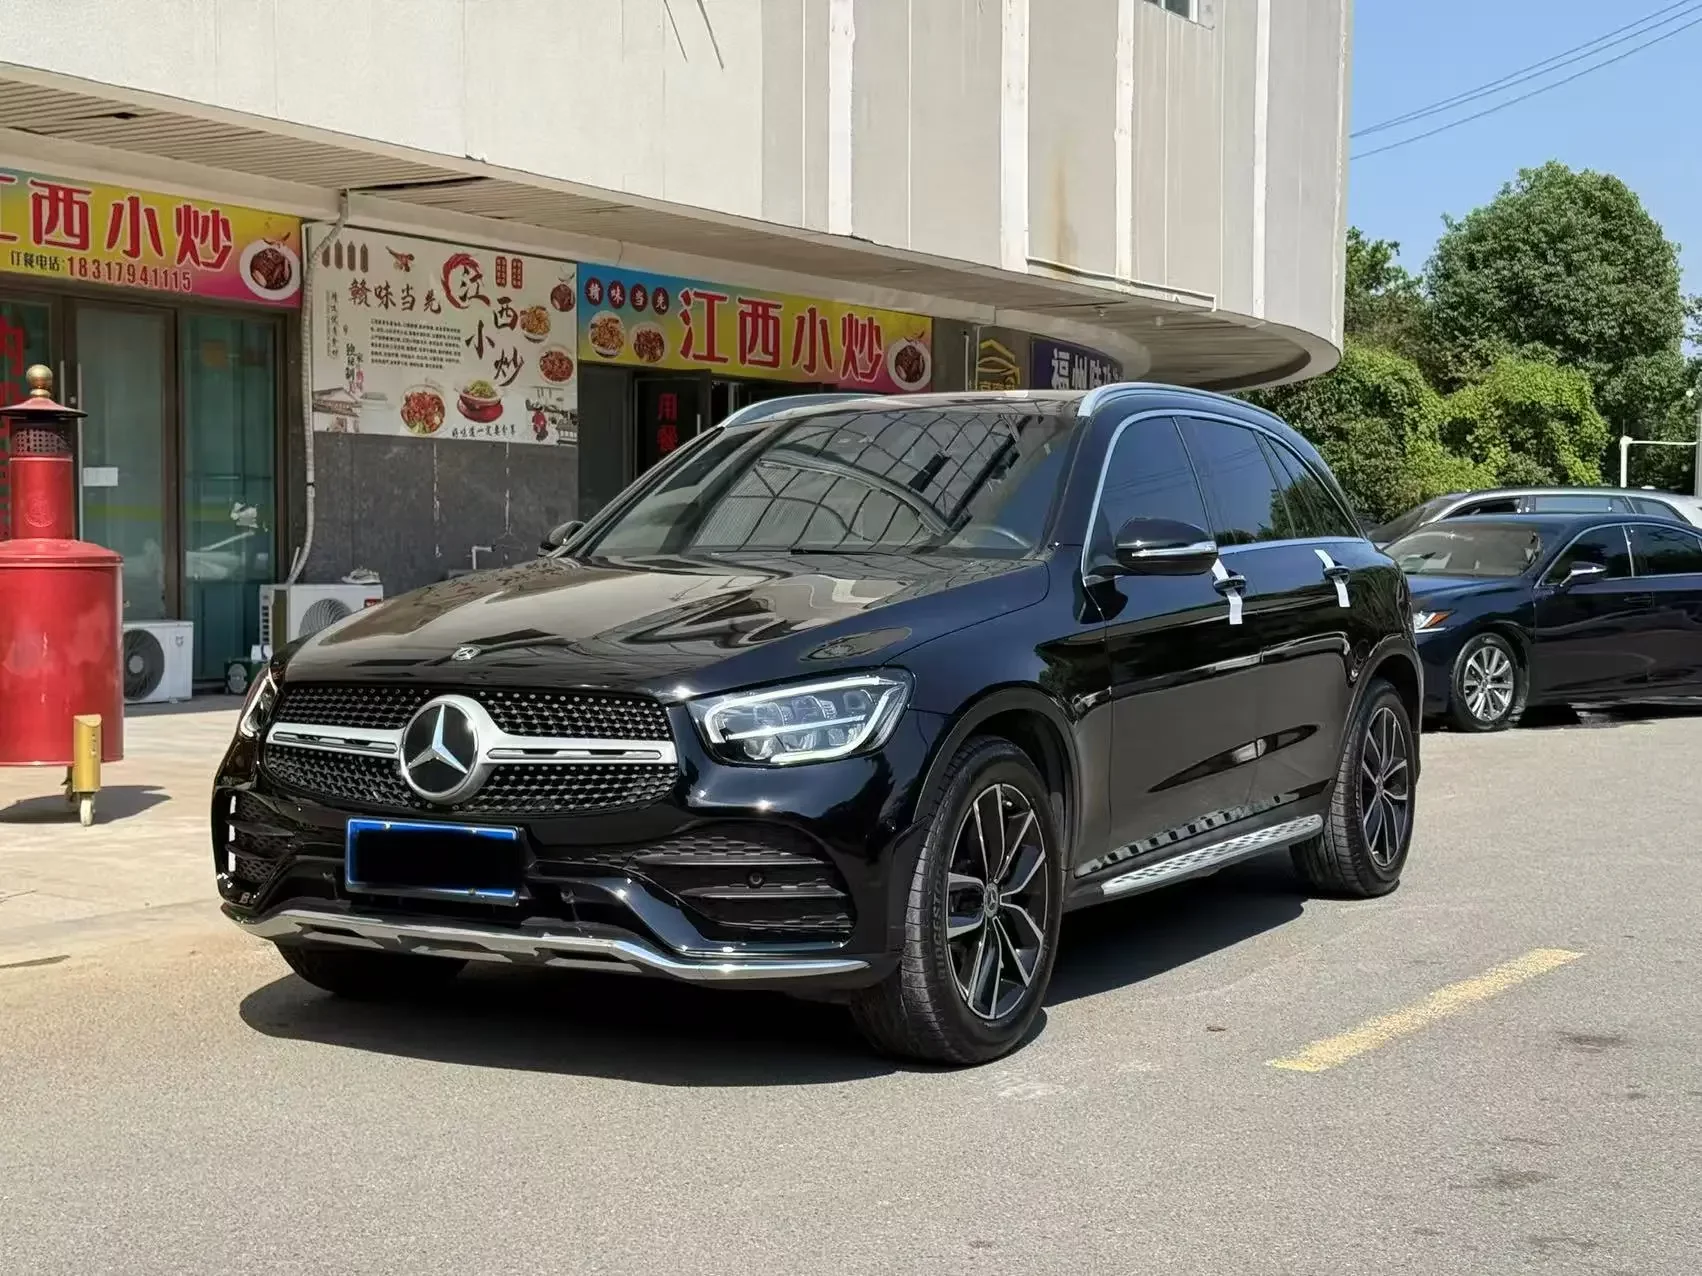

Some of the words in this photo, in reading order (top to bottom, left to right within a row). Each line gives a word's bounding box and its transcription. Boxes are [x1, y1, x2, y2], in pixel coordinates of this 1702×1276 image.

[67, 256, 192, 292] 18317941115
[678, 289, 885, 382] 江西小炒
